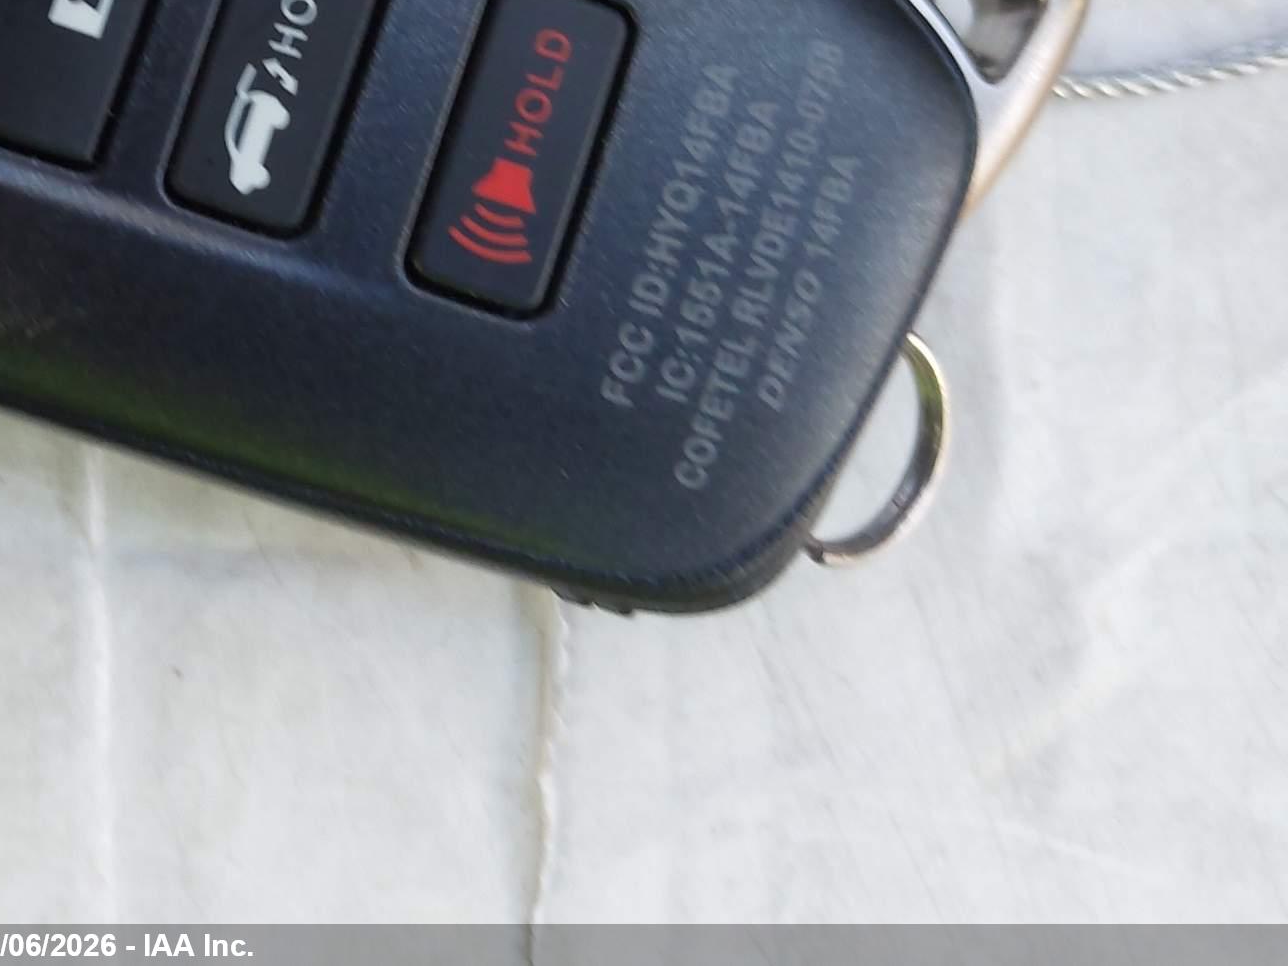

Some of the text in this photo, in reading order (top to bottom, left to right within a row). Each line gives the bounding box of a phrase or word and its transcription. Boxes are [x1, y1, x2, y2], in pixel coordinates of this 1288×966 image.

[504, 28, 572, 156] HOLD
[600, 63, 739, 408] FCC ID:HYQ14FBA
[656, 99, 781, 404] IC:1551A-14FBA
[756, 153, 863, 413] DENSO 14FBA
[673, 335, 758, 492] COFETEL
